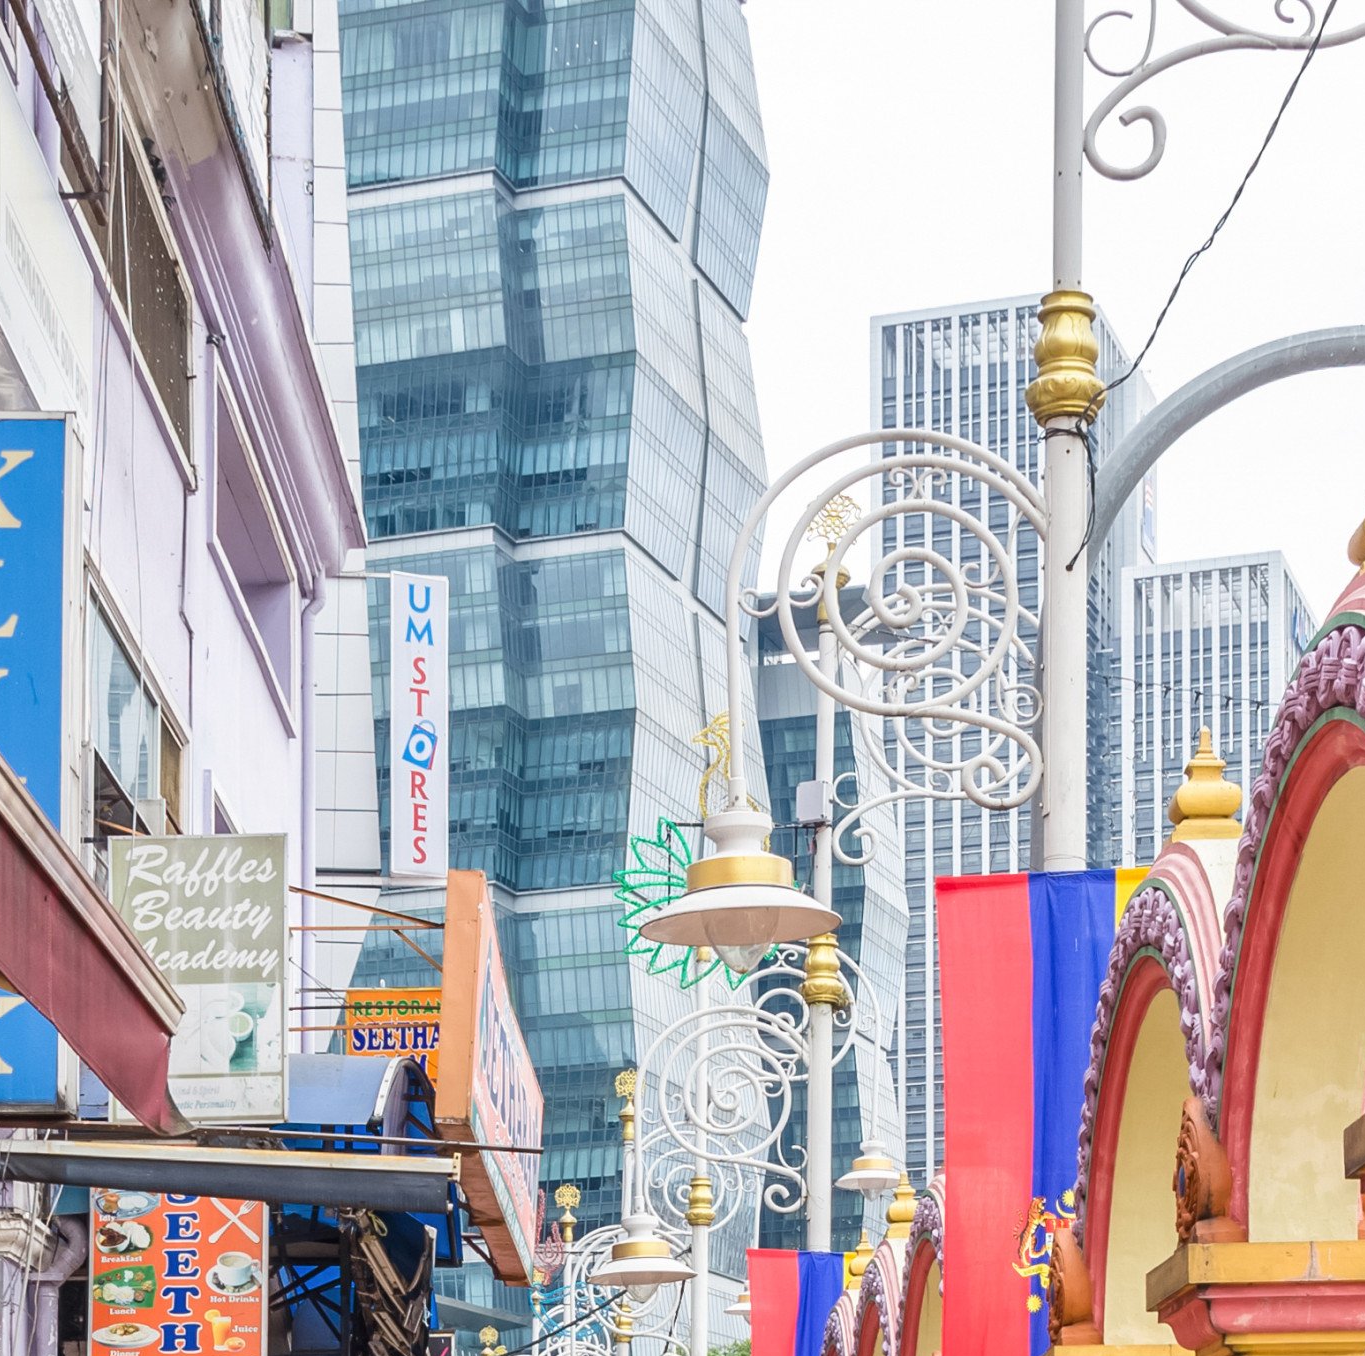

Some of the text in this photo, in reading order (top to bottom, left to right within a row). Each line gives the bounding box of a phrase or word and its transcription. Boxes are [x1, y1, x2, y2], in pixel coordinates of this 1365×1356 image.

[405, 583, 434, 646] UM
[408, 657, 433, 864] STORES
[125, 845, 277, 897] Raffles
[131, 890, 273, 940] Beauty
[101, 1254, 143, 1264] Breakfast
[109, 1307, 137, 1316] Lunch
[210, 1295, 260, 1304] Hot Drinks
[232, 1325, 259, 1334] Juice
